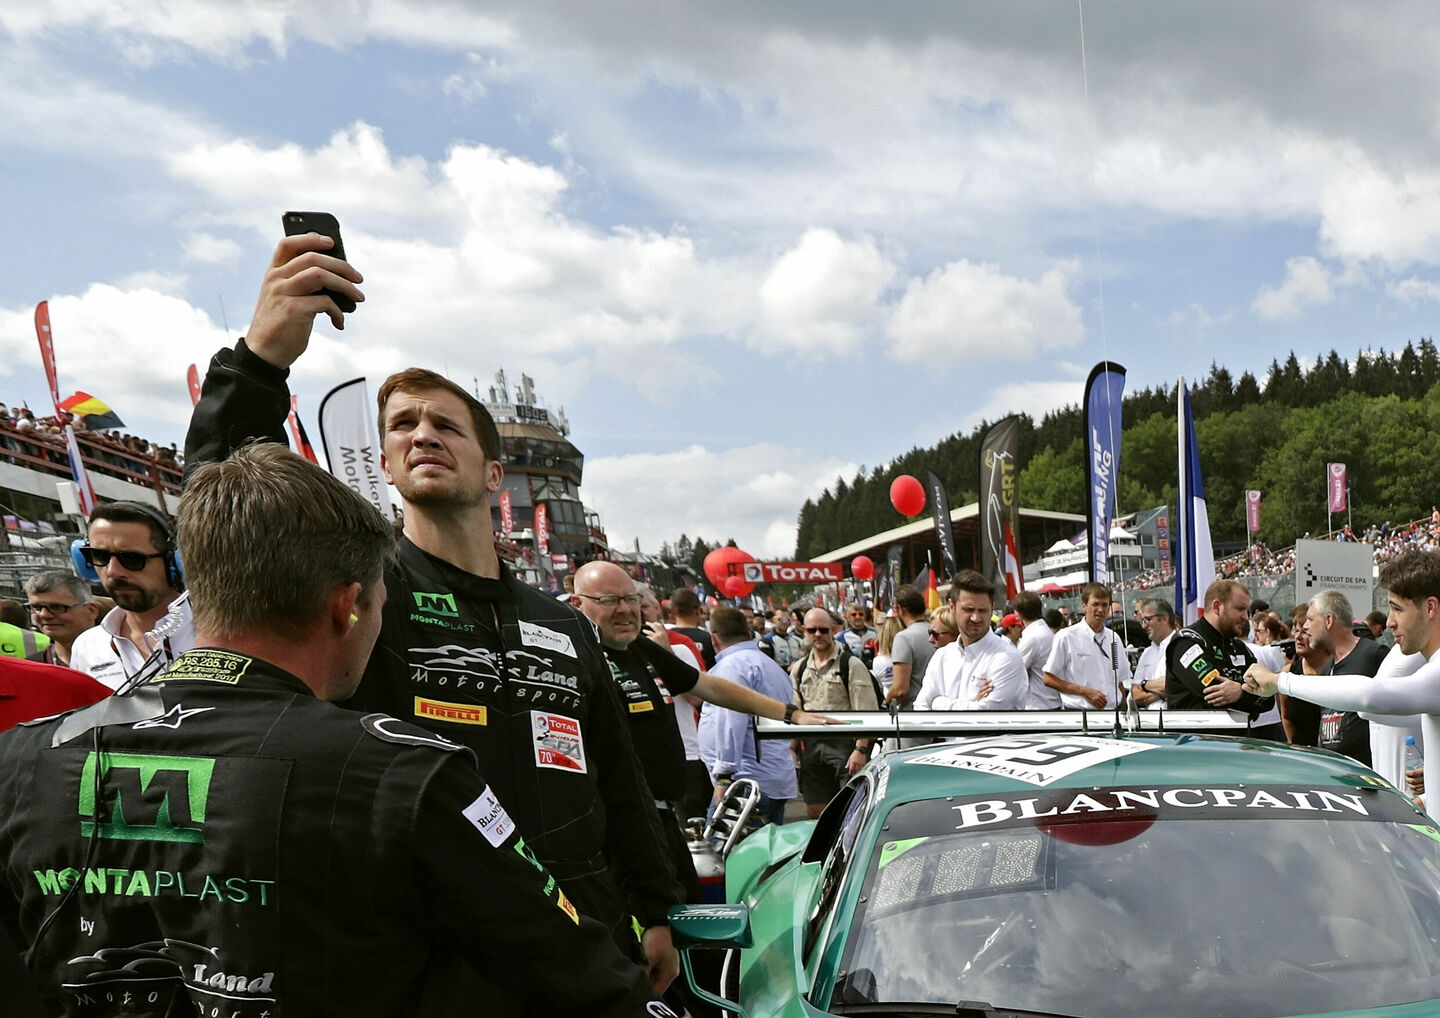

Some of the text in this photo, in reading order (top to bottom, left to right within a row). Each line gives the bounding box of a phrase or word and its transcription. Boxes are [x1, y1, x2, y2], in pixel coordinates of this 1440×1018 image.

[1001, 459, 1014, 507] GRT
[537, 508, 547, 544] TOTAL
[765, 565, 838, 580] TOTAL
[1320, 575, 1344, 583] CIRCUIT
[410, 614, 475, 632] MONTAPLAST
[526, 665, 578, 689] Land
[419, 701, 481, 722] PIRELLI
[550, 718, 578, 733] TOTAL
[541, 751, 552, 763] 70
[542, 737, 582, 760] SPA
[914, 756, 1053, 783] BLANCPAIN
[951, 788, 1371, 830] BLANCPAIN
[33, 867, 276, 906] MONTAPLAST
[80, 916, 95, 936] by
[193, 963, 275, 993] Land
